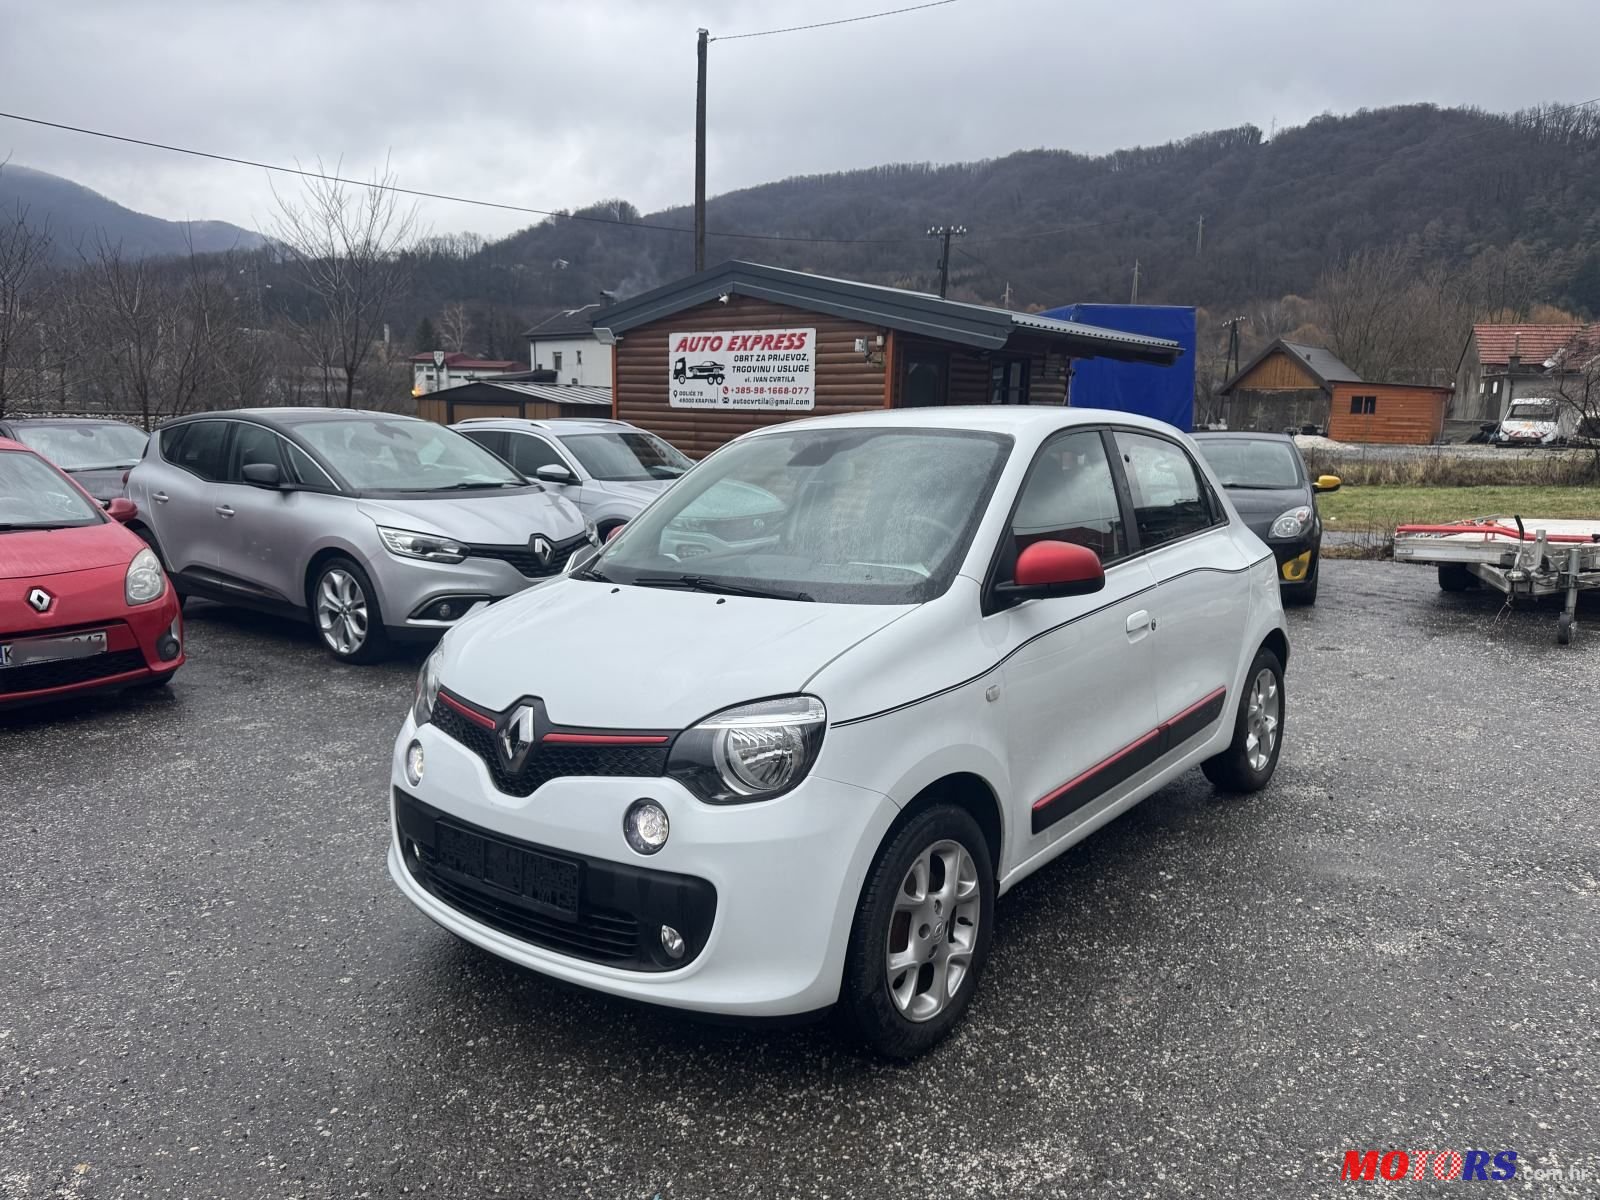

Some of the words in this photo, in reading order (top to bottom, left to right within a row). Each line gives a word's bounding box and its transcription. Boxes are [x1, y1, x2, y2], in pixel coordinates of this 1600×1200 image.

[675, 335, 723, 352] AUTO
[726, 333, 807, 351] EXPRESS
[734, 354, 754, 362] OBRT
[755, 354, 766, 362] ZA
[767, 353, 809, 362] PRIJEVOZ,
[732, 365, 771, 373] TRGOVINU
[777, 365, 810, 373] USLUGE
[731, 387, 809, 395] +385-98-1668-077
[732, 398, 810, 407] autocvrtila@gmail.com
